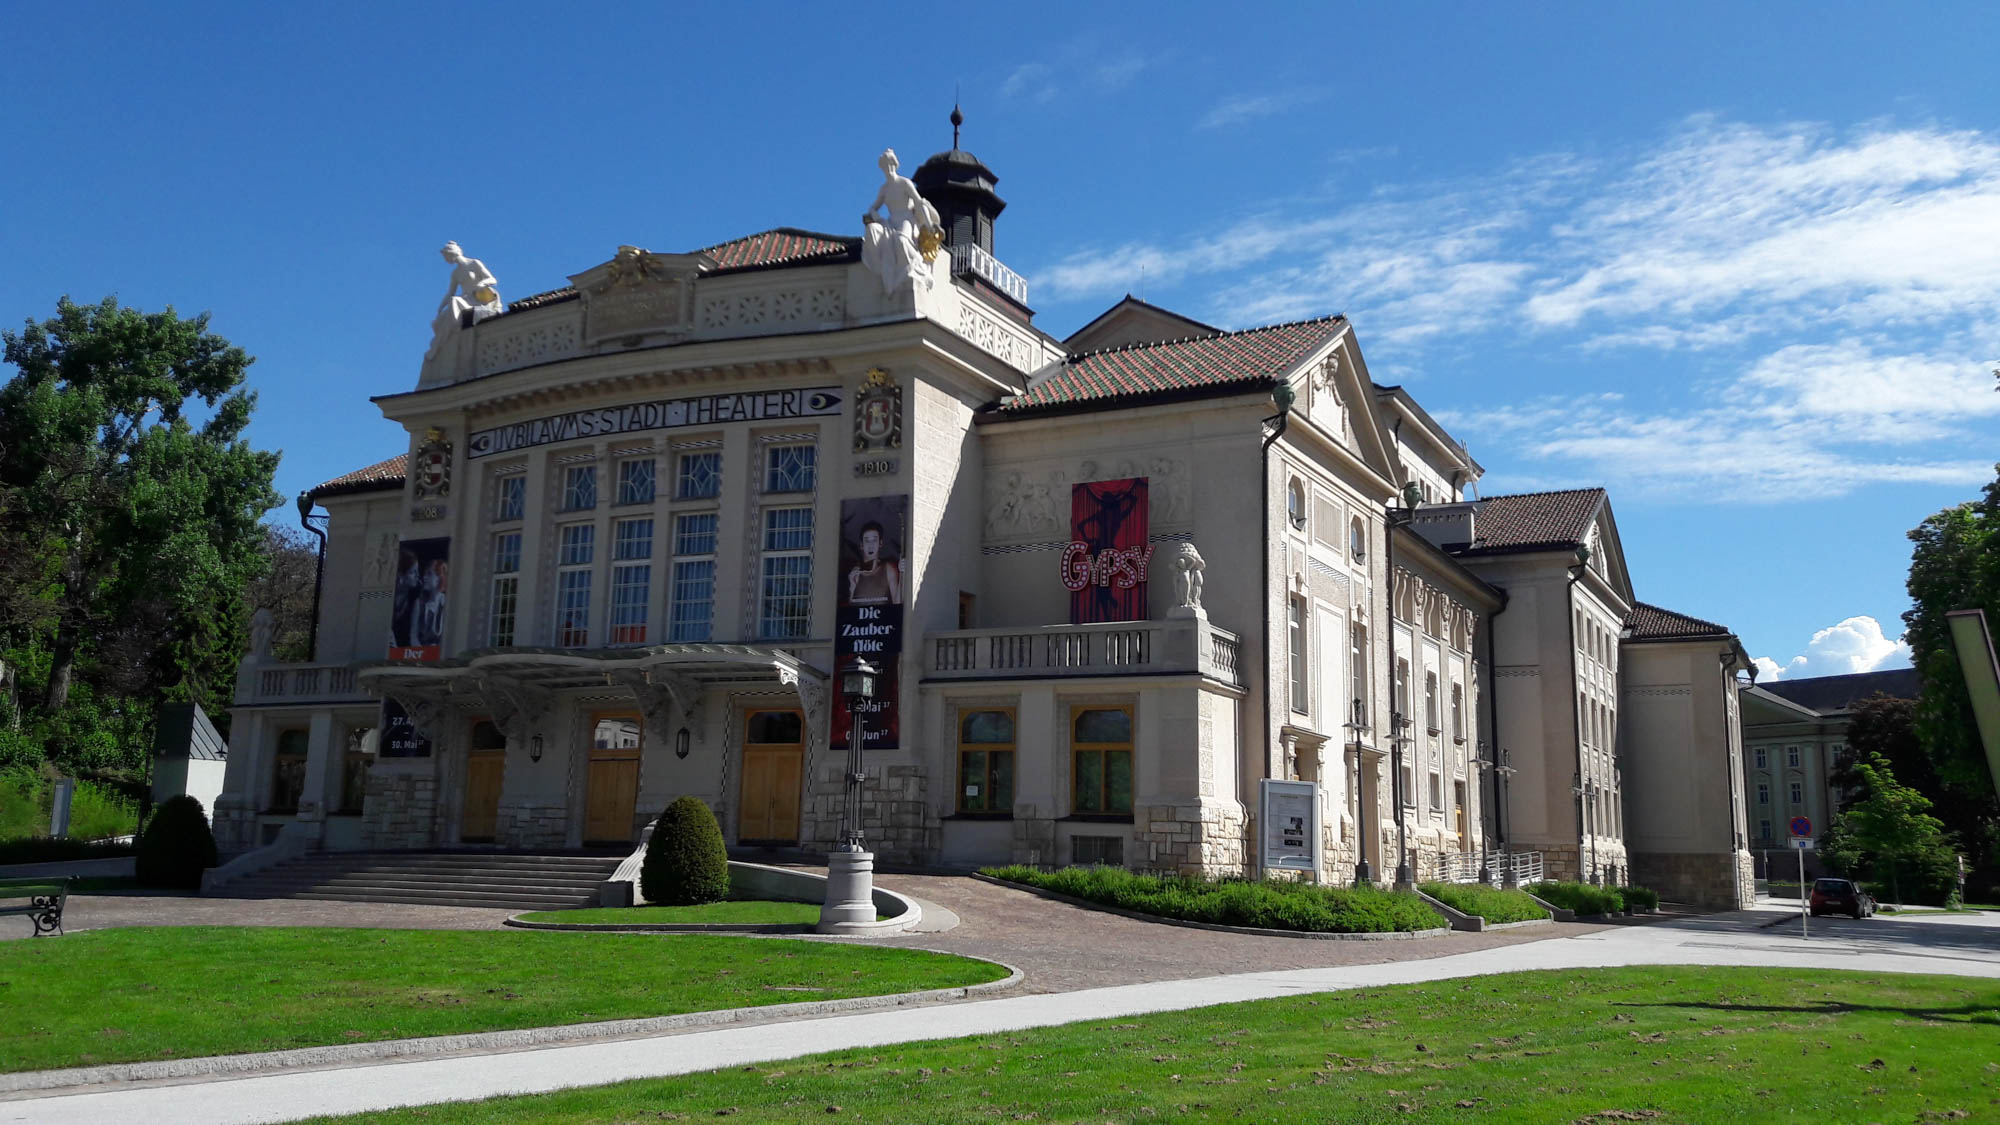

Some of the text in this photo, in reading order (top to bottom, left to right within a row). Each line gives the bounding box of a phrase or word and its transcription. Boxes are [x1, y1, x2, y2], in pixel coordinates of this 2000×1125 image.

[600, 401, 672, 433] STADT
[681, 391, 797, 424] THEATER
[864, 461, 889, 475] 1910
[1060, 540, 1155, 592] GYPSY
[858, 606, 881, 620] Die
[853, 638, 884, 653] flöte
[403, 648, 424, 659] Der
[863, 730, 880, 741] Jun
[404, 740, 417, 749] Mai
